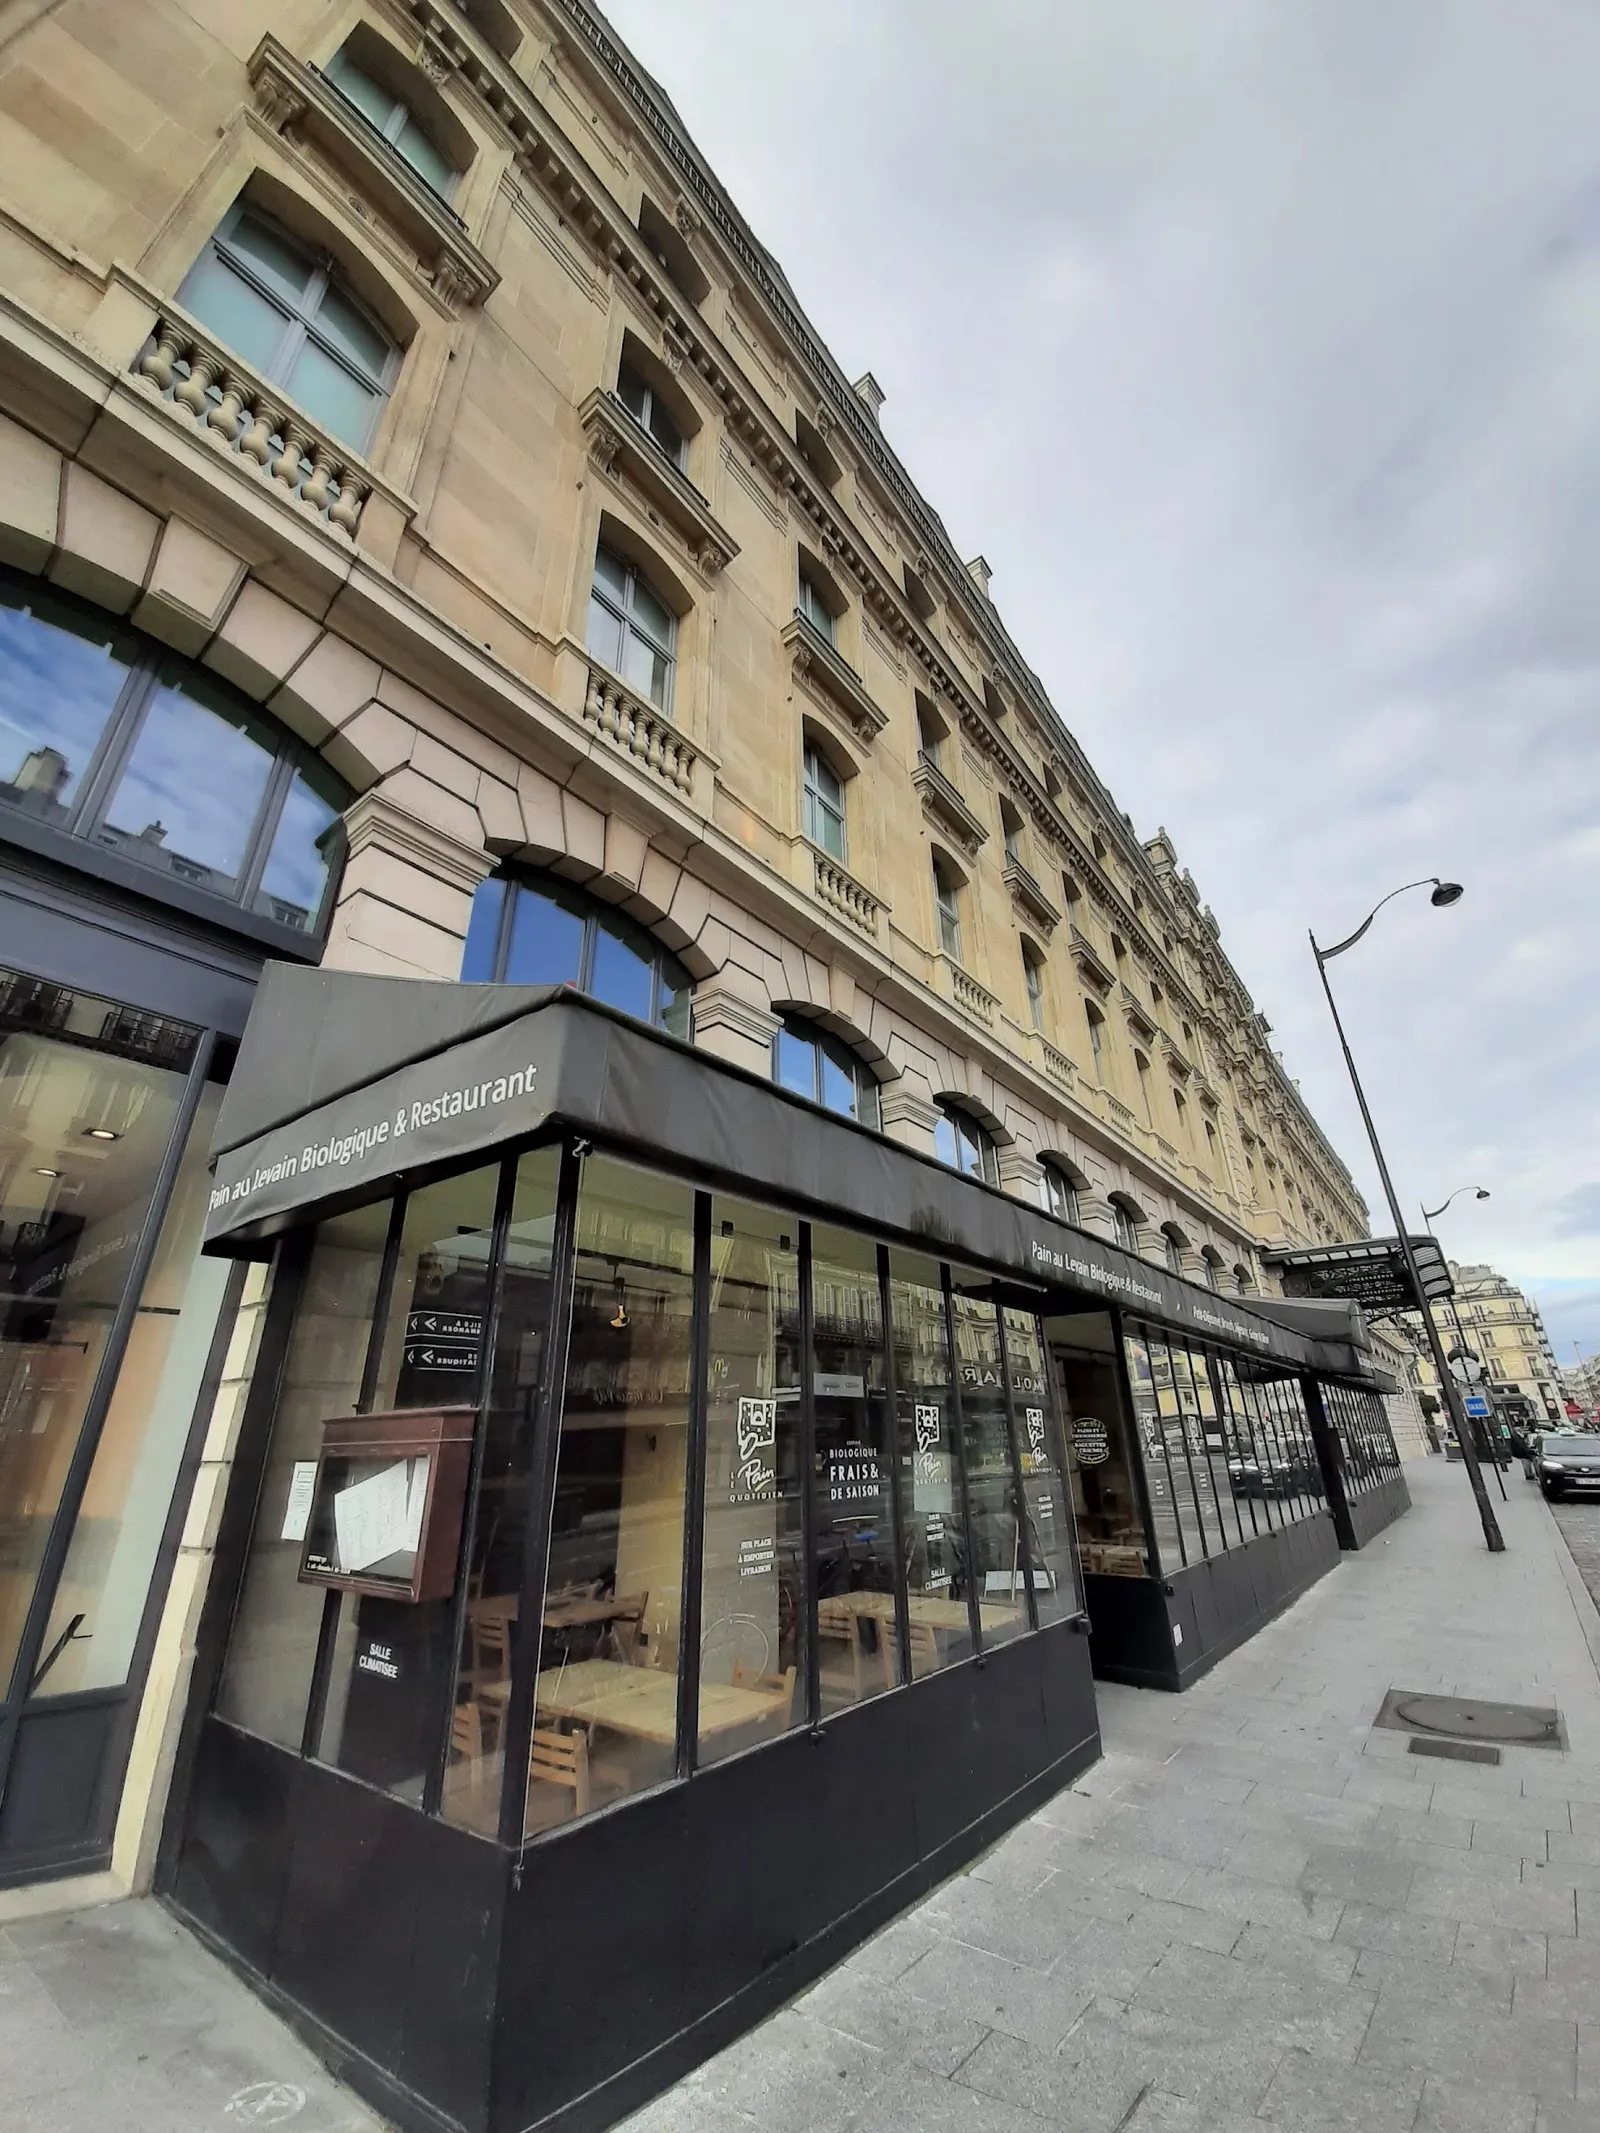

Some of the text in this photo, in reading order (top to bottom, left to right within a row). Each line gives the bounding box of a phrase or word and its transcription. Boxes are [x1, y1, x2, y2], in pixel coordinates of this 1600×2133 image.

[208, 1062, 538, 1212] Pain au Levain Biologique & Restaurant
[1032, 1240, 1163, 1305] Pain au Levain Biologique & Restaurant
[829, 1447, 878, 1459] BIOLOGIQUE
[918, 1452, 942, 1478] Pain
[737, 1458, 775, 1492] Pain
[729, 1491, 785, 1503] QUOTIDIEN
[830, 1484, 879, 1501] DE SAISON
[740, 1564, 772, 1576] LIVRAISON
[930, 1566, 946, 1579] SALLE
[369, 1643, 392, 1660] SALLE
